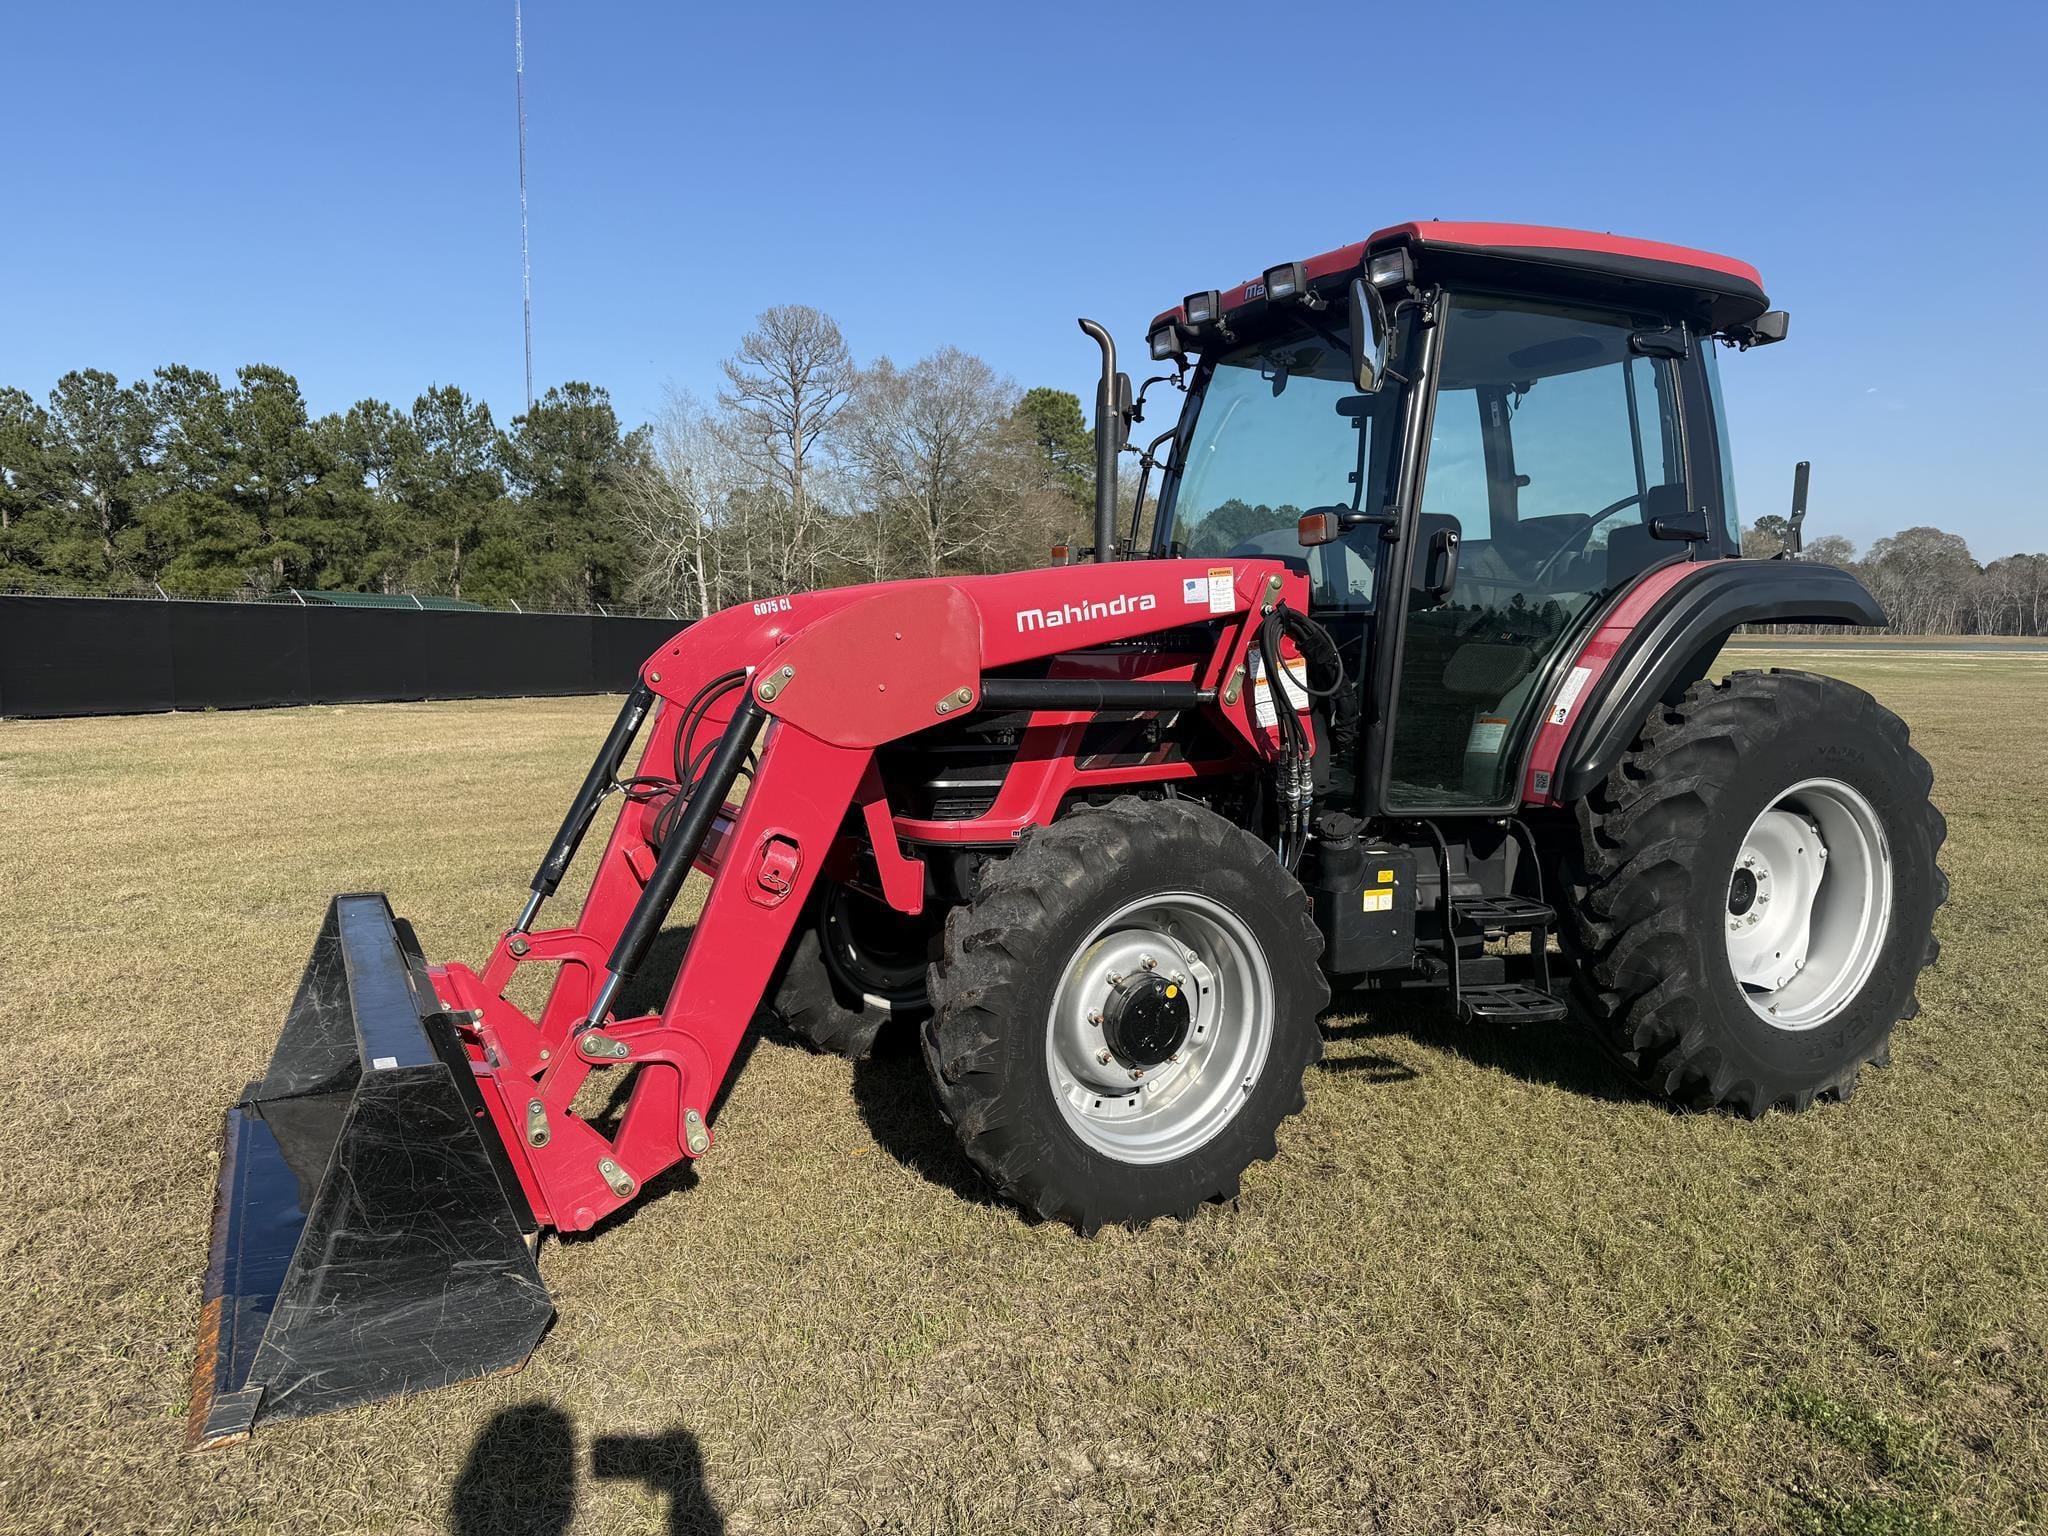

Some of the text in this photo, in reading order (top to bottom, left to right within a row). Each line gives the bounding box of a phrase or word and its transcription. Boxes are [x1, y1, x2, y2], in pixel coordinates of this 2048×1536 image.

[753, 597, 792, 616] 6075 CL
[1016, 594, 1157, 633] Mahindra
